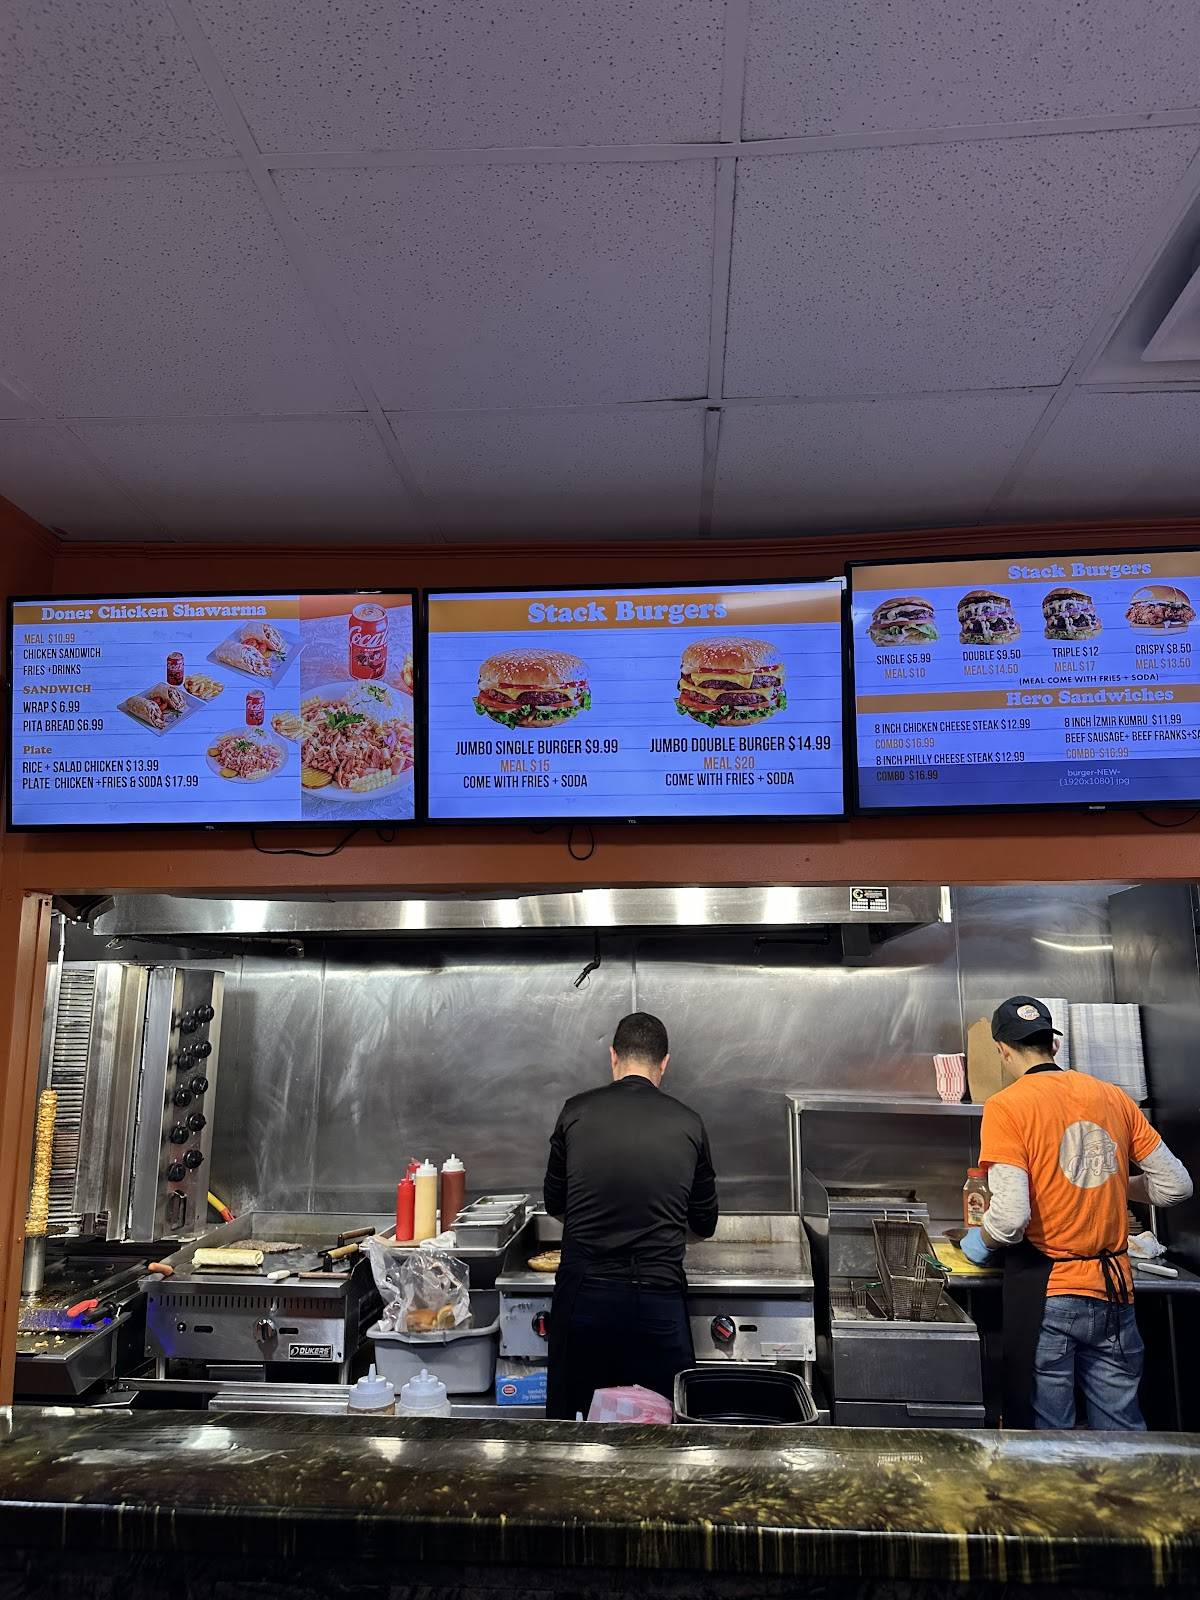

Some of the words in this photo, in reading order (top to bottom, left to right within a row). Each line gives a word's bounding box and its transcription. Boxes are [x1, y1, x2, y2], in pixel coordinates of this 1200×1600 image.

[1008, 564, 1065, 580] Stack
[1072, 562, 1152, 579] Burgers
[41, 607, 93, 621] Doner
[98, 605, 168, 619] Chicken
[173, 603, 267, 618] Shawarma
[527, 602, 608, 624] Stack
[615, 601, 727, 625] Burgers
[24, 634, 44, 644] MEAL
[48, 633, 75, 644] $10.99
[23, 649, 57, 659] CHICKEN
[59, 647, 101, 659] SANDWICH
[1052, 647, 1080, 657] TRIPLE
[1082, 646, 1099, 657] $12
[1135, 644, 1164, 655] CRISPY
[1167, 643, 1191, 654] $8.50
[877, 655, 904, 665] SINGLE
[907, 653, 931, 665] $5.99
[963, 650, 994, 661] DOUBLE
[997, 650, 1021, 660] $9.50
[1054, 662, 1077, 672] MEAL
[1079, 661, 1095, 672] $17
[1136, 659, 1159, 669] MEAL
[1161, 657, 1191, 669] $13.50
[23, 665, 45, 676] FRIES
[885, 669, 908, 679] MEAL
[909, 668, 925, 678] $10
[964, 665, 987, 675] MEAL
[1019, 676, 1045, 686] (MEAL
[1047, 676, 1073, 684] COME
[1075, 675, 1097, 683] WITH
[1131, 673, 1159, 681] SODA)
[23, 684, 91, 695] SANDWICH
[1007, 692, 1053, 706] Hero
[1059, 688, 1174, 704] Sandwiches
[23, 701, 48, 713] WRAP
[59, 701, 80, 712] 6.99
[23, 720, 42, 732] PITA
[46, 719, 75, 732] BREAD
[78, 719, 103, 731] $6.99
[875, 724, 880, 733] 8
[883, 724, 901, 733] INCH
[940, 721, 971, 732] CHEESE
[973, 720, 999, 731] STEAK
[1001, 719, 1031, 730] $12.99
[1065, 718, 1070, 727] 8
[1072, 717, 1091, 727] INCH
[1119, 715, 1148, 725] KUMRU
[1152, 714, 1182, 725] $11.99
[1066, 733, 1085, 743] BEEF
[1132, 731, 1152, 741] BEEF
[455, 740, 493, 756] JUMBO
[495, 740, 535, 755] SINGLE
[538, 739, 582, 754] BURGER
[585, 738, 618, 754] $9.99
[649, 738, 688, 753] JUMBO
[692, 737, 736, 753] DOUBLE
[740, 736, 785, 752] BURGER
[788, 735, 831, 752] $14.99
[876, 739, 903, 749] COMBO
[906, 738, 935, 748] $16.99
[23, 746, 52, 754] Plate
[1067, 748, 1095, 758] COMBO
[703, 756, 732, 770] MEAL
[735, 755, 755, 770] $20
[876, 756, 881, 765] 8
[884, 756, 902, 765] INCH
[905, 754, 932, 764] PHILLY
[934, 754, 965, 764] CHEESE
[966, 753, 993, 763] STEAK
[995, 751, 1025, 763] $12.99
[23, 761, 42, 773] RICE
[53, 761, 81, 773] SALAD
[84, 760, 123, 772] CHICKEN
[126, 759, 159, 772] $13.99
[500, 759, 527, 773] MEAL
[529, 758, 550, 773] $15
[463, 775, 491, 789] COME
[494, 775, 518, 788] WITH
[521, 775, 549, 788] FRIES
[561, 774, 587, 788] SODA
[665, 773, 694, 787] COME
[697, 773, 723, 786] WITH
[726, 772, 754, 786] FRIES
[767, 771, 794, 785] SODA
[877, 771, 904, 781] COMBO
[909, 770, 938, 780] $16.99
[22, 778, 50, 789] PLATE
[54, 777, 93, 789] CHICKEN
[130, 776, 136, 787] &
[138, 776, 162, 787] SODA
[165, 775, 198, 787] $17.99
[300, 1347, 330, 1356] DUKERS
